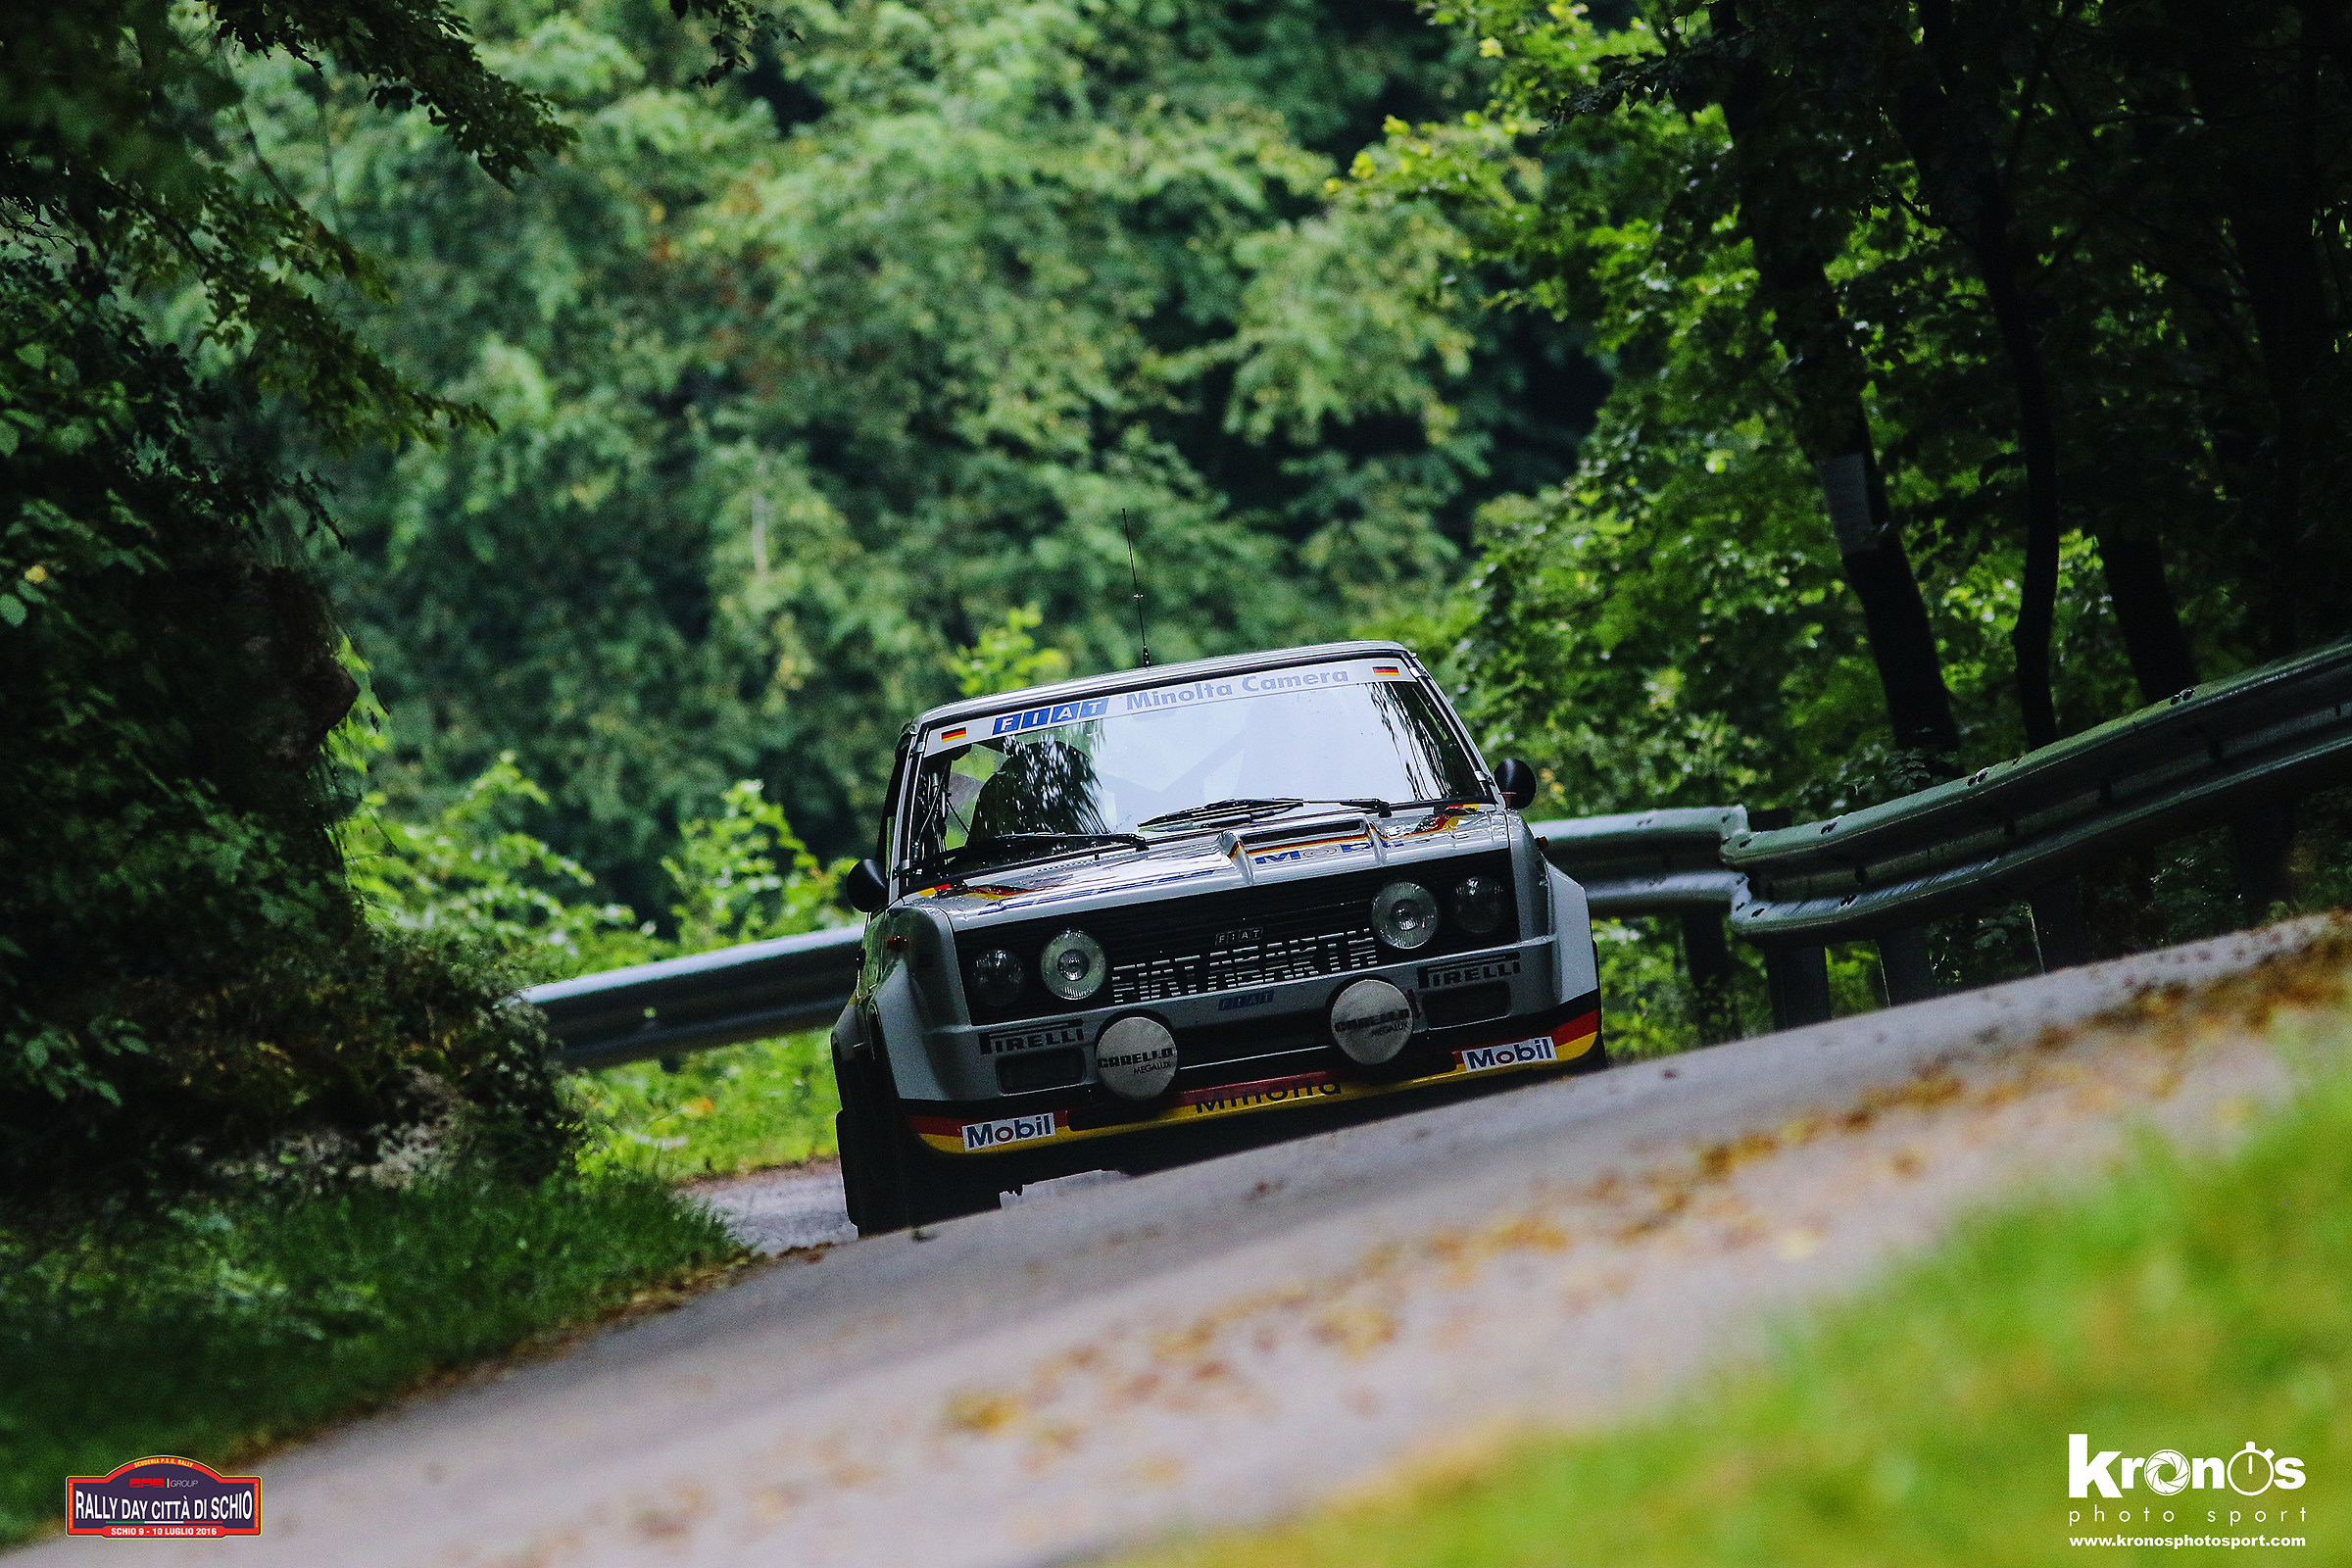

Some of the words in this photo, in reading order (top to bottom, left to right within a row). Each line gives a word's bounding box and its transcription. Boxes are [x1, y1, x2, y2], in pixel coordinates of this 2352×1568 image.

[1126, 680, 1234, 711] Minolta
[1242, 668, 1349, 694] Camera
[994, 698, 1108, 736] FIAT
[1216, 928, 1262, 945] FIAT
[1207, 927, 1378, 992] ABARTH
[1417, 951, 1521, 989] PIRELLI
[1218, 991, 1274, 1010] FIAT
[980, 1019, 1084, 1055] PIRELLI
[1469, 1038, 1553, 1070] Mobil
[1098, 1048, 1173, 1068] CARELLO
[1133, 1061, 1171, 1075] MEGALUX
[1195, 1080, 1342, 1113] Minolta
[967, 1114, 1052, 1149] Mobil
